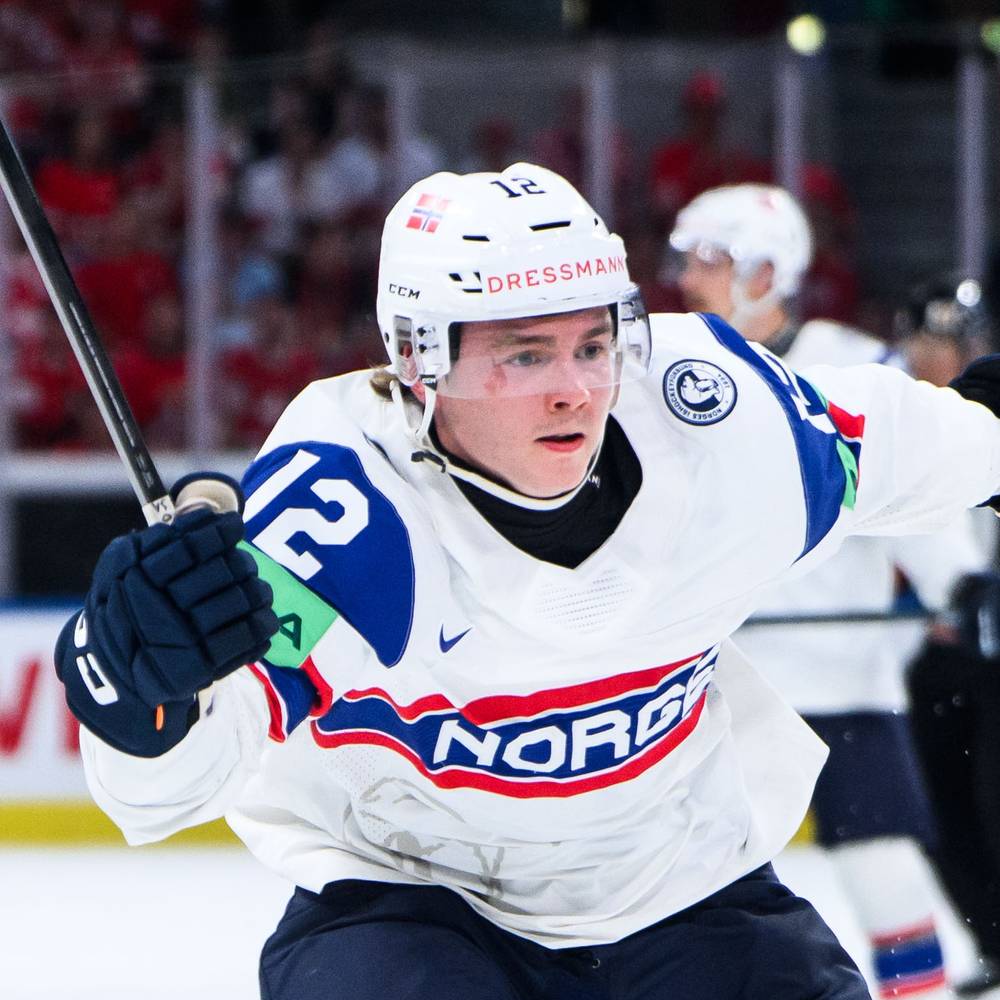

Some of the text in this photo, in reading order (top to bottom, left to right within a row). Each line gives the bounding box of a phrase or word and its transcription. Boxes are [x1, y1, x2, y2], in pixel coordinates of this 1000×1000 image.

[490, 177, 546, 198] 12
[487, 255, 625, 294] DRESSMANN
[389, 283, 420, 299] CCM
[242, 448, 369, 581] 12
